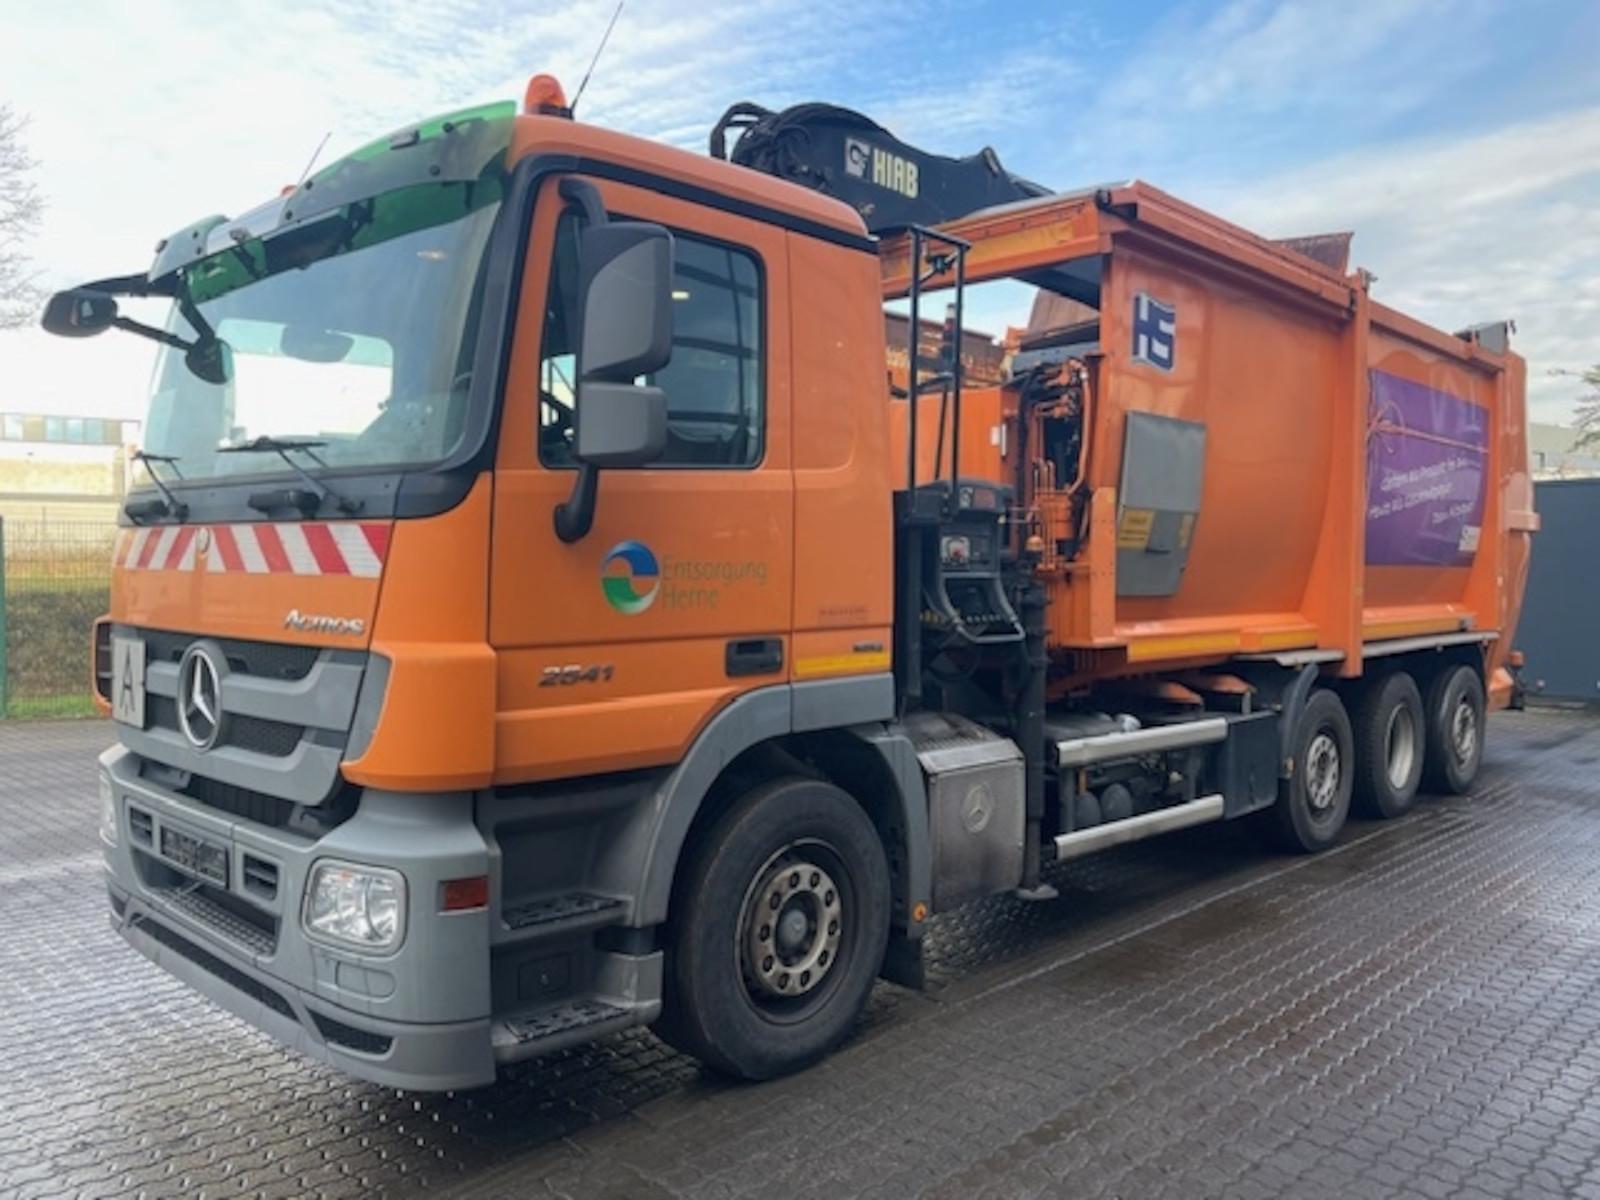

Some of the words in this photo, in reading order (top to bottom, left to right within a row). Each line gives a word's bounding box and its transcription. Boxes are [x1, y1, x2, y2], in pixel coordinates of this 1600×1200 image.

[873, 148, 919, 199] HIAB
[662, 555, 768, 586] Entsorgung
[662, 583, 719, 610] Herne
[119, 643, 137, 714] A
